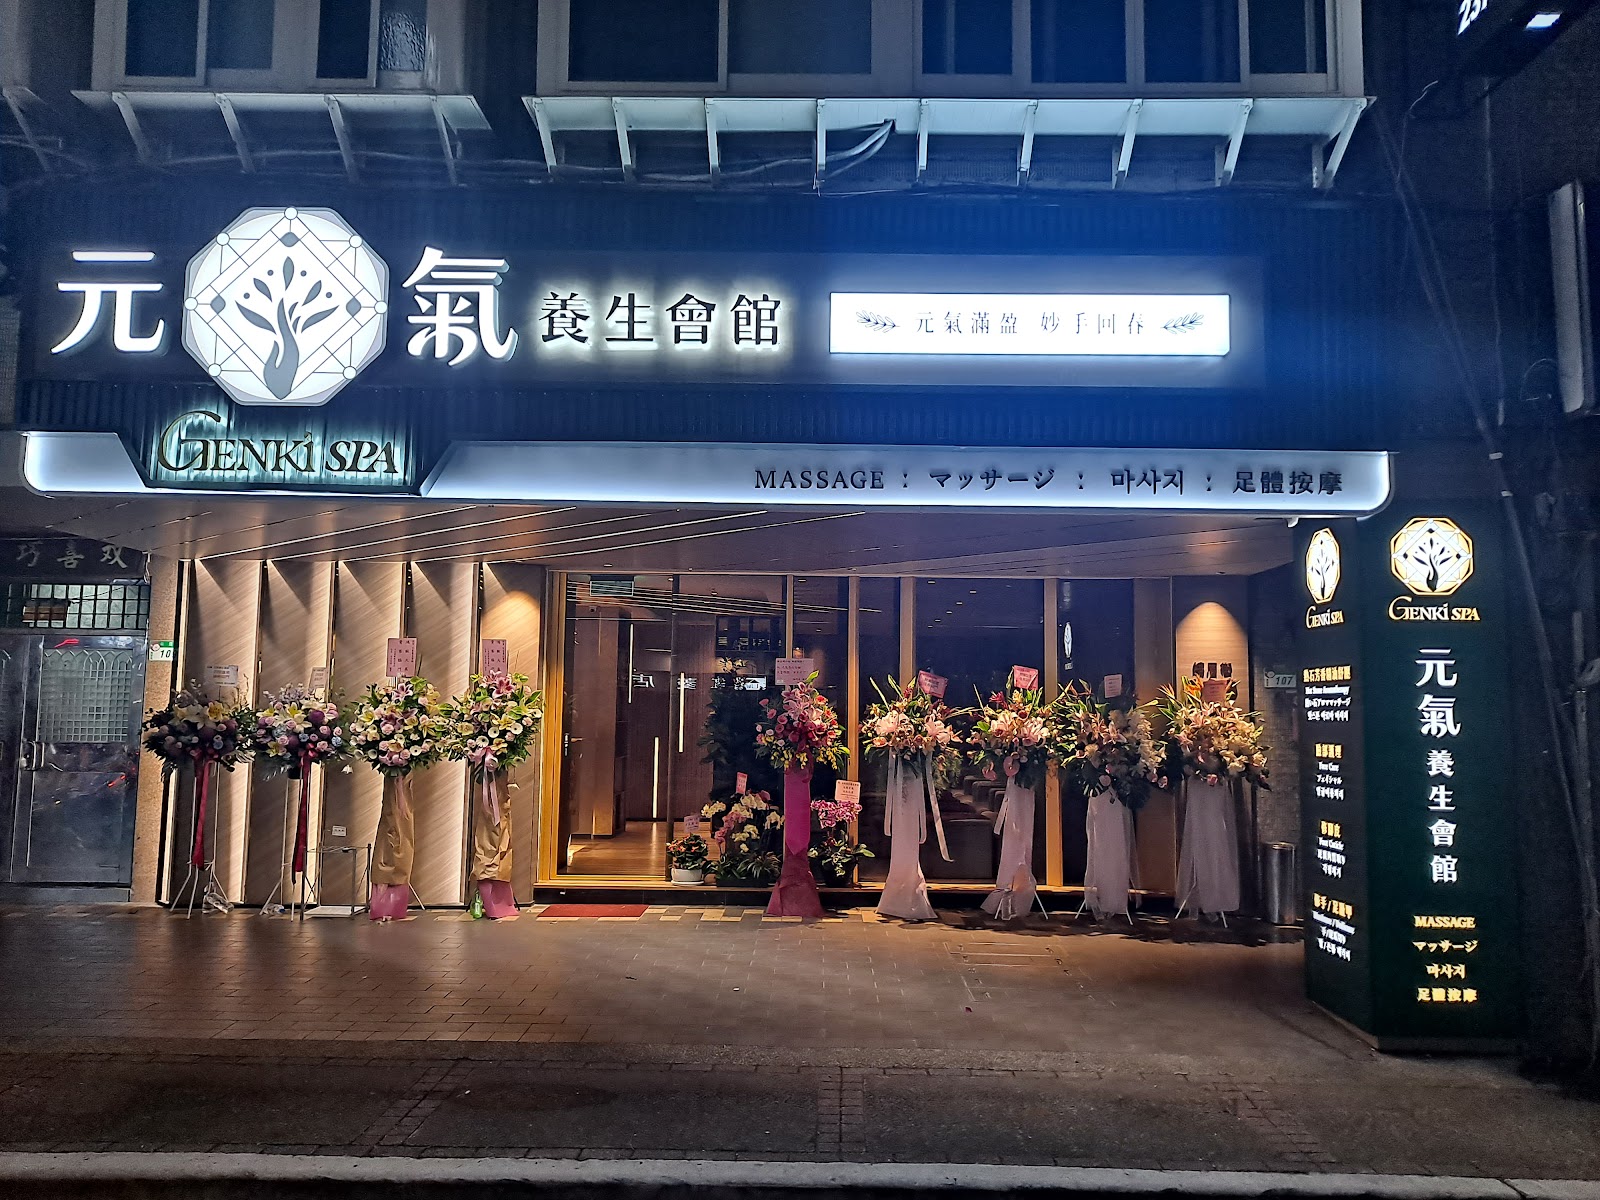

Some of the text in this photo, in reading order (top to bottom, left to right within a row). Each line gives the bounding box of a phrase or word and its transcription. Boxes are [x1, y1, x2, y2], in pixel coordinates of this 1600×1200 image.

[538, 293, 783, 352] 養生會館
[918, 311, 1143, 334] 元氣滿盈 妙手回春
[325, 440, 399, 473] SPA
[756, 465, 1342, 496] MASSAGE マッサージ 마사지 足體按摩
[1331, 610, 1344, 624] SPA
[1451, 608, 1480, 621] SPA
[1276, 676, 1293, 685] 107
[1414, 915, 1476, 928] MASSAGE
[1412, 939, 1478, 954] マッサージ
[1425, 963, 1466, 980] 마사지
